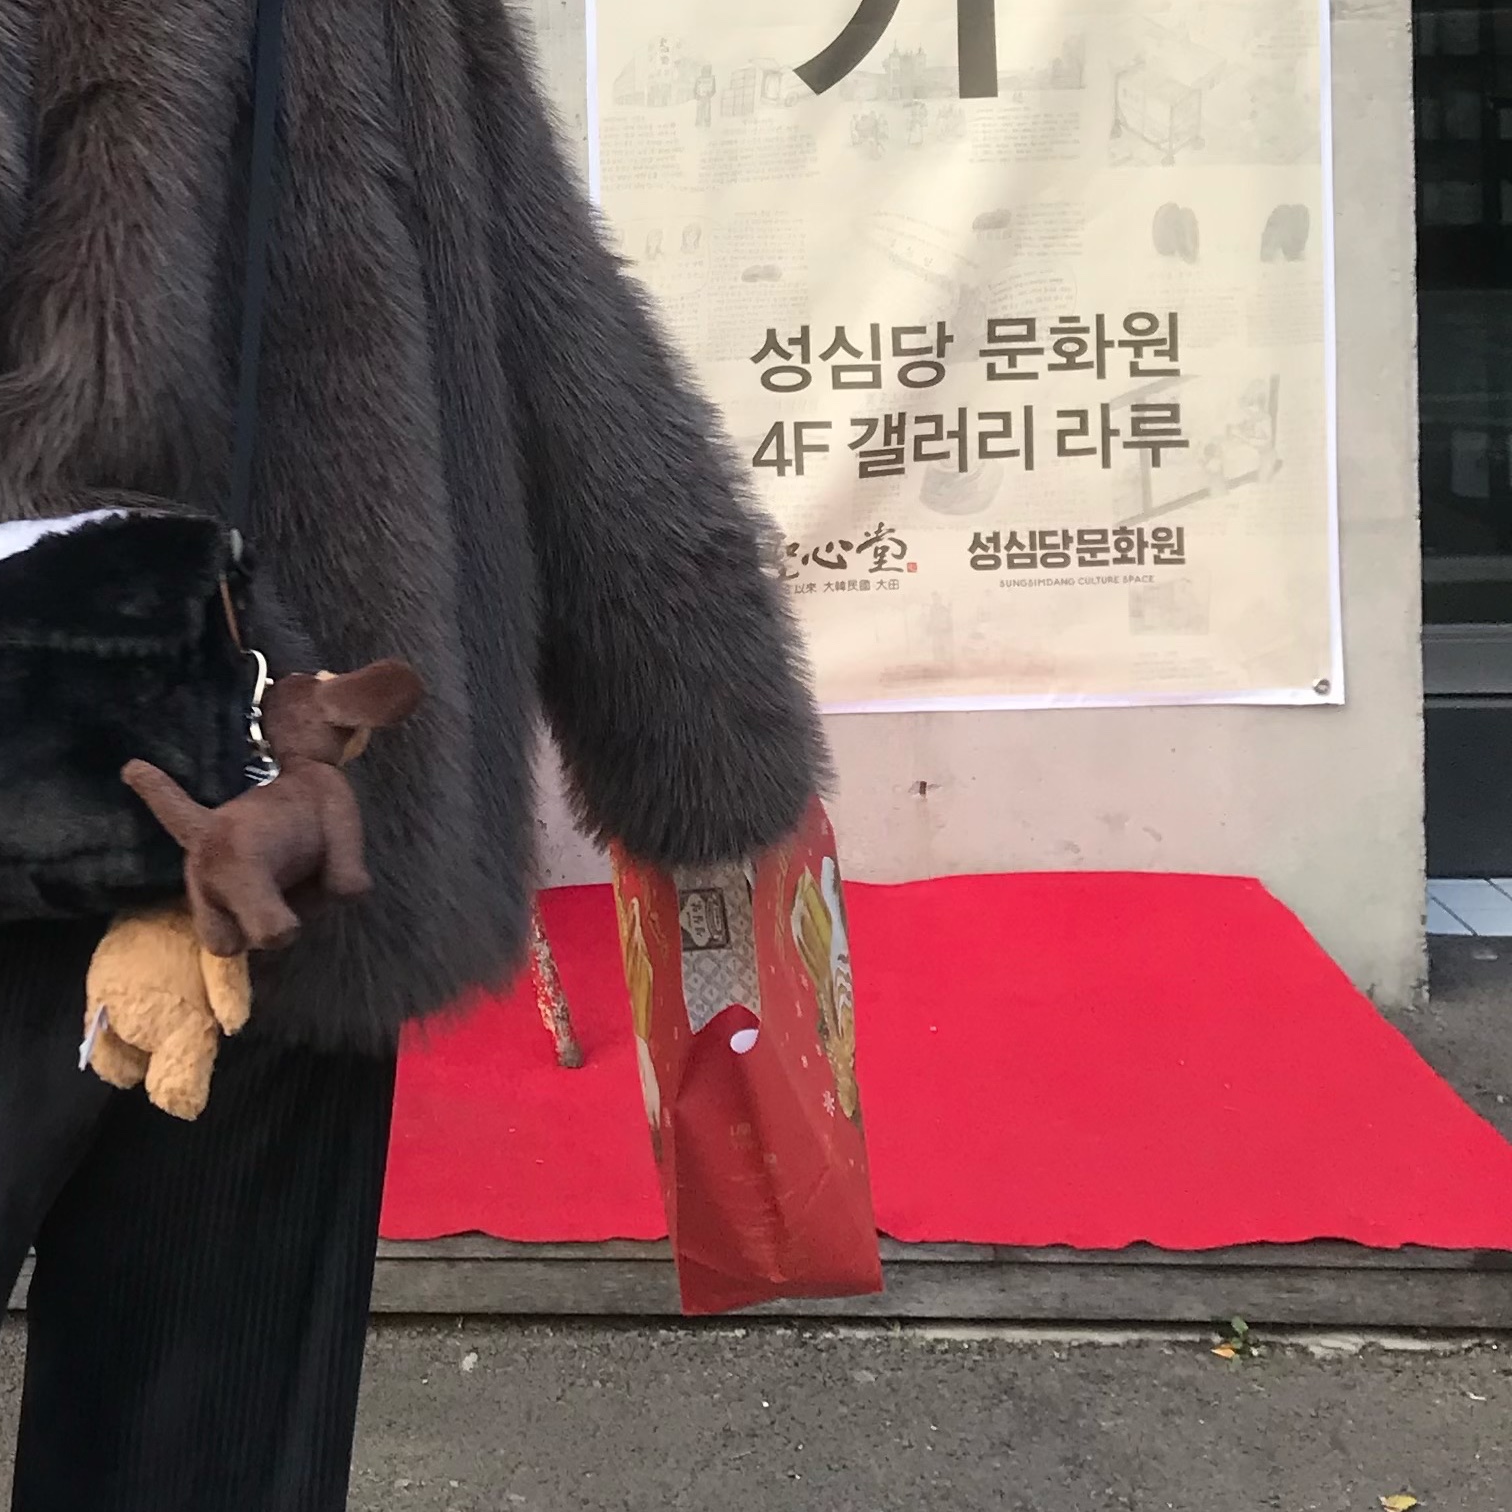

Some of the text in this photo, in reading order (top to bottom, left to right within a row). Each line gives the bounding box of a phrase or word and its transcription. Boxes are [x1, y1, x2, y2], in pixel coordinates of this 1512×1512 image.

[749, 311, 1181, 393] 성심당 문화원
[752, 402, 1190, 479] 4F 갤러리 라루
[967, 525, 1186, 571] 성심당문화원
[999, 574, 1155, 588] SUNGSIMDANG CULTURE SPACE
